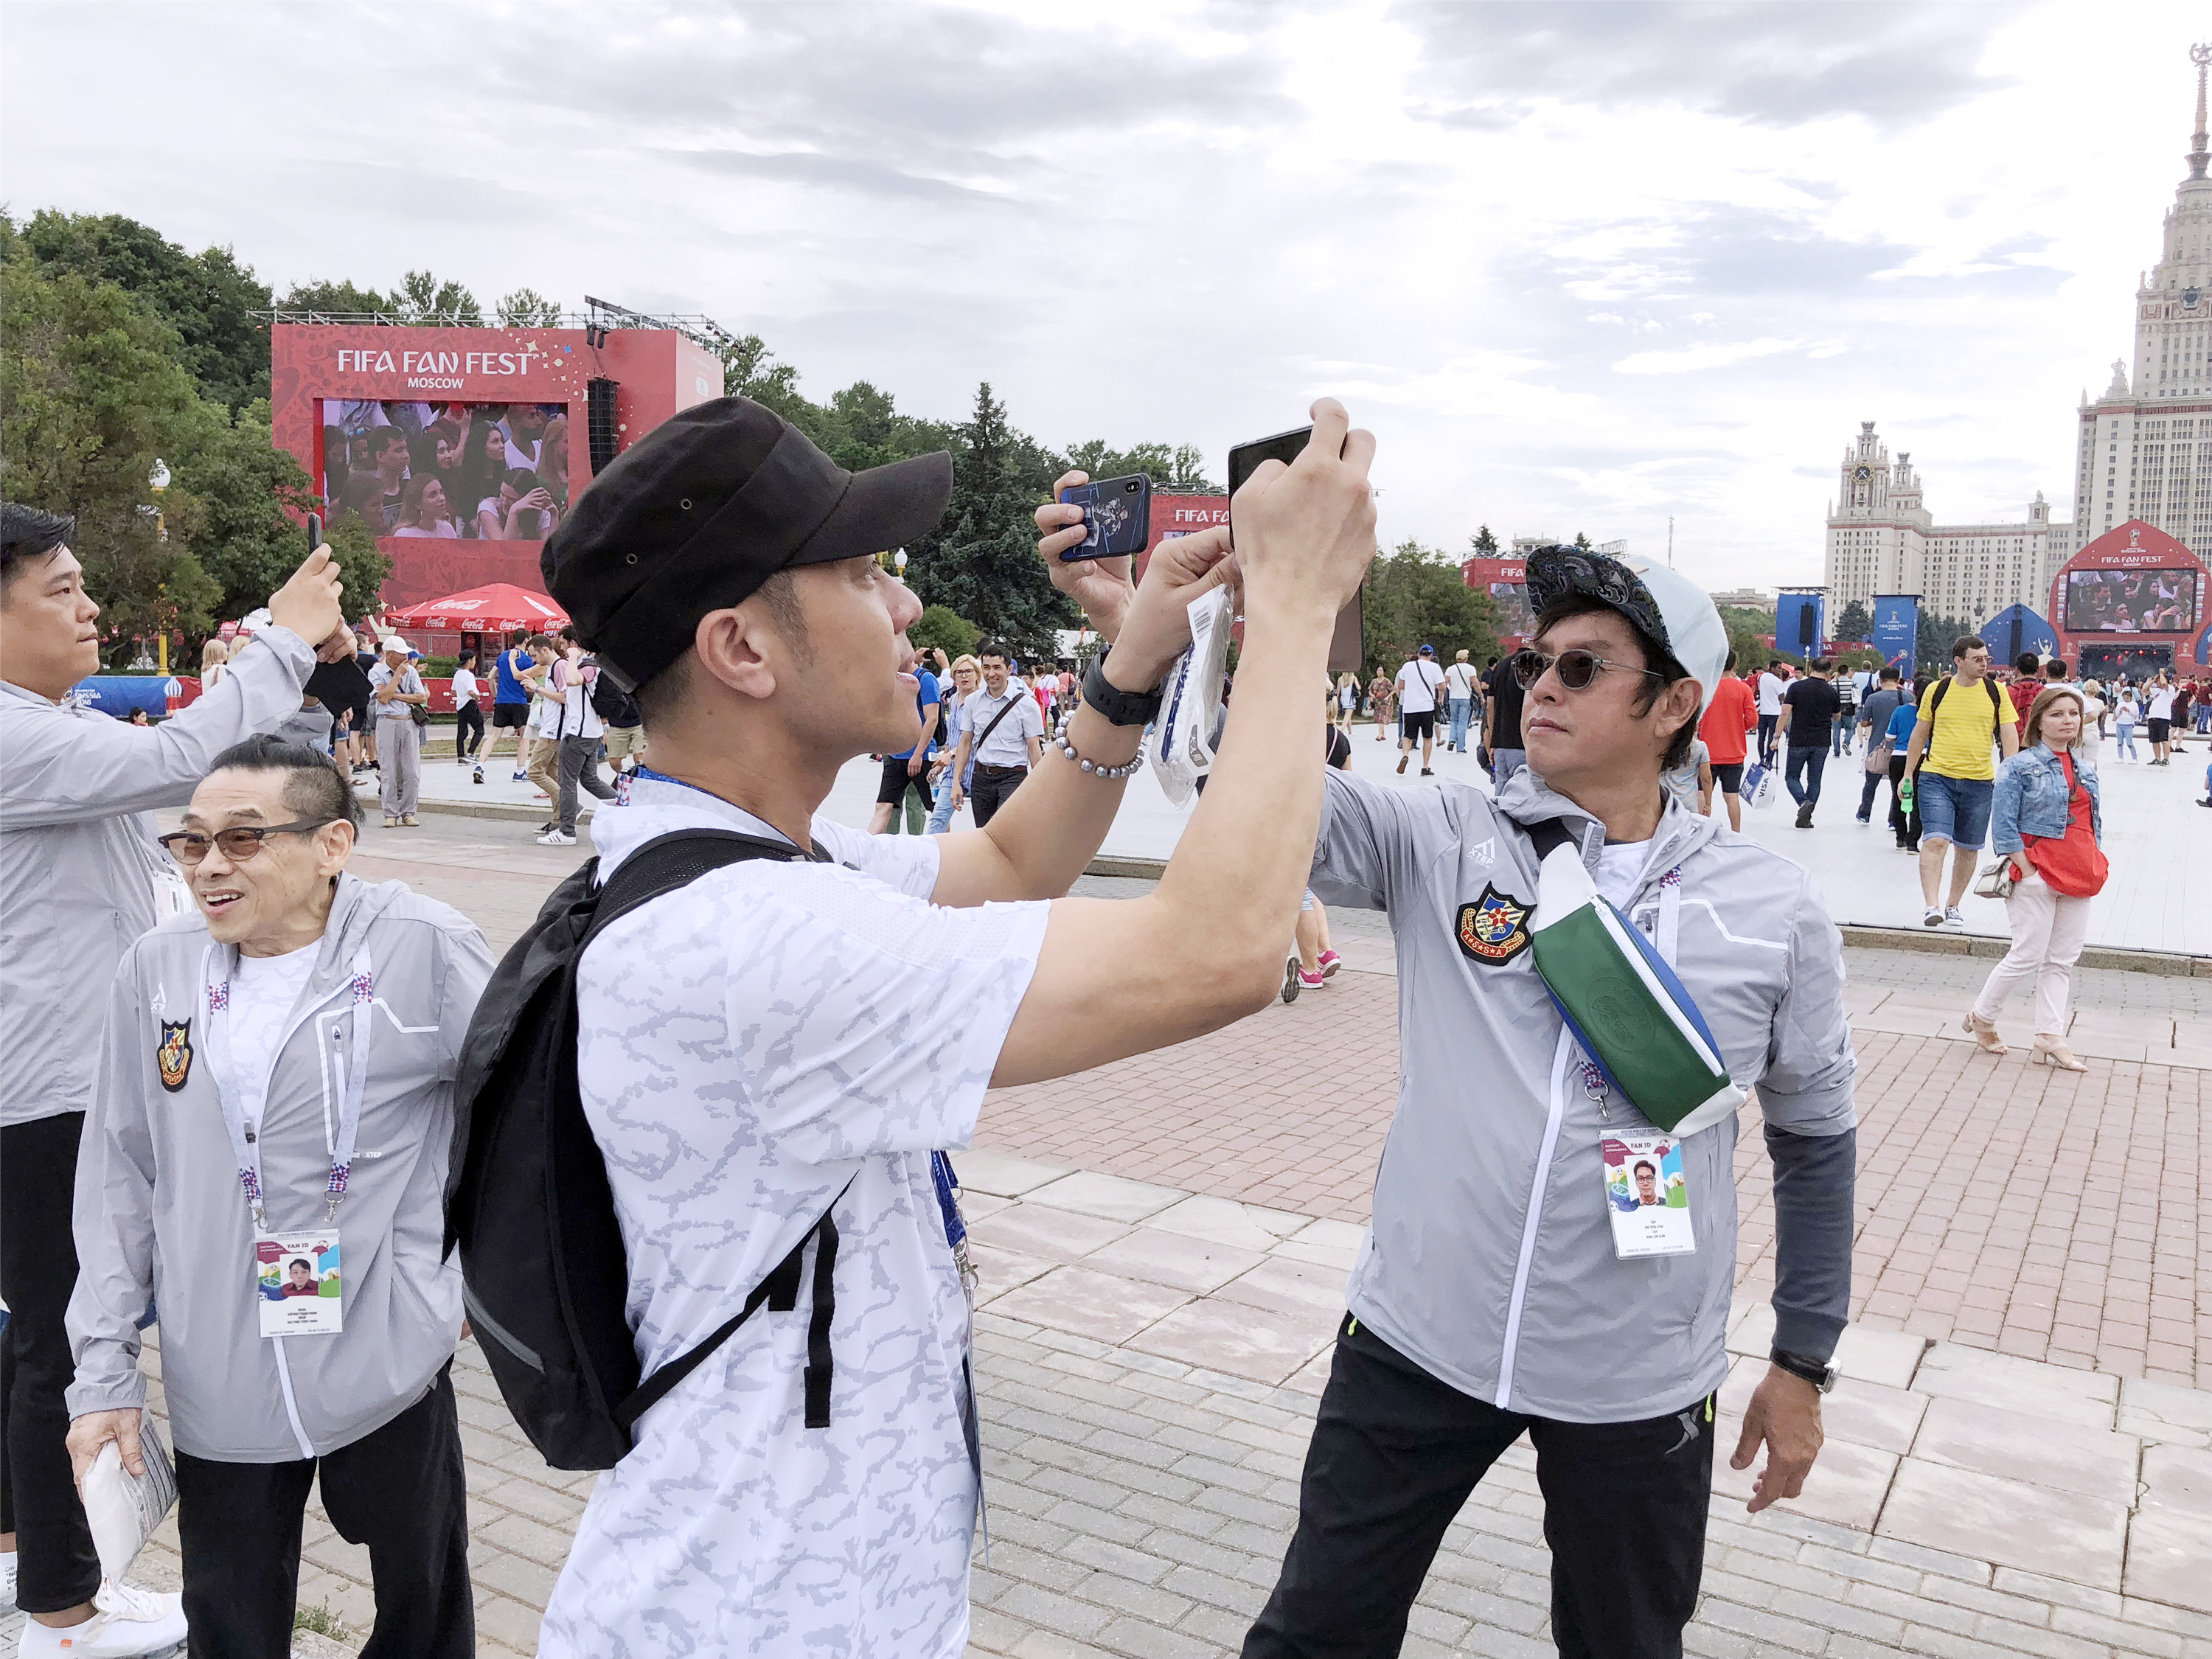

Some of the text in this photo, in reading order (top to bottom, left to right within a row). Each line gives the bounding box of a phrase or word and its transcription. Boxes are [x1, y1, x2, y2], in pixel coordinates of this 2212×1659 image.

[338, 349, 533, 375] FIFA FAN FEST
[407, 377, 465, 389] MOSCOW
[1175, 509, 1229, 523] FIFA FA
[1500, 568, 1524, 577] FIFA
[462, 617, 487, 630] Coca-Cola
[1758, 777, 1770, 798] VISA
[1466, 853, 1490, 870] OUTDOOR
[1469, 847, 1494, 865] XTEP
[151, 1002, 166, 1012] XTP
